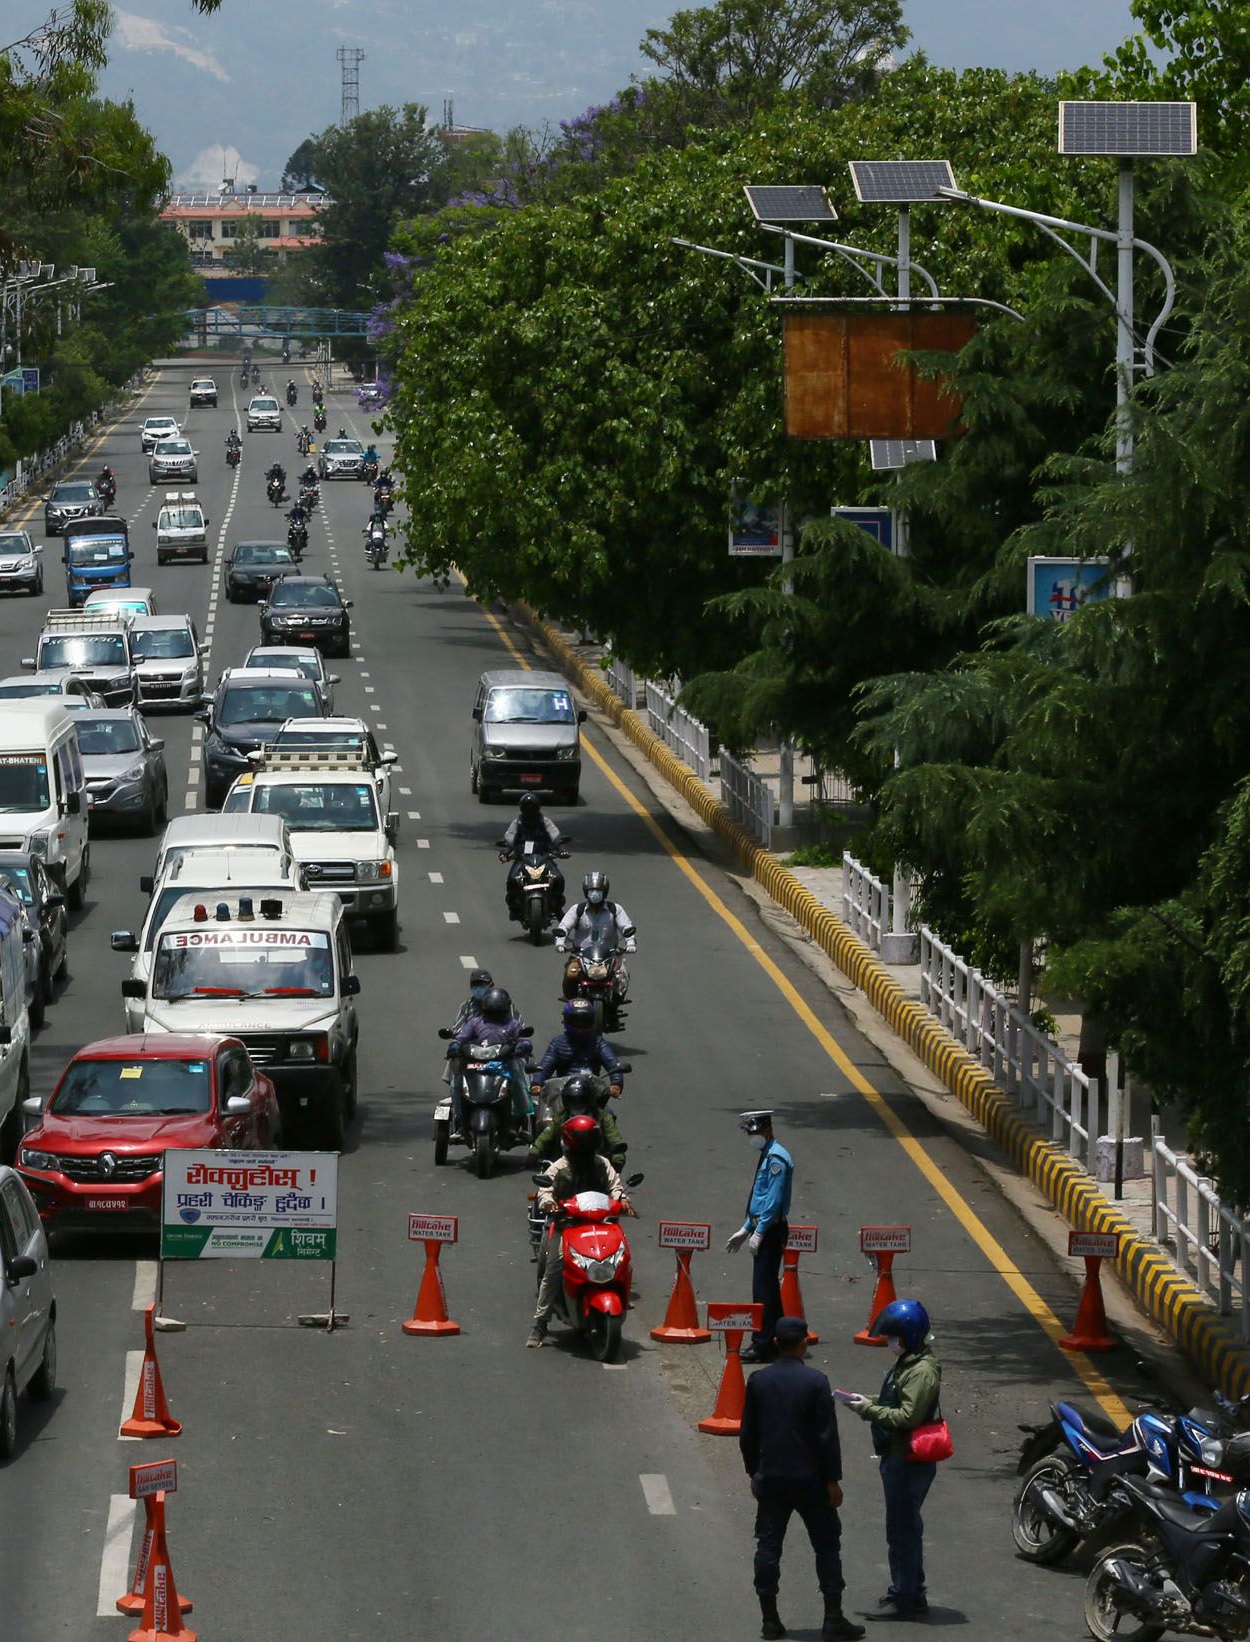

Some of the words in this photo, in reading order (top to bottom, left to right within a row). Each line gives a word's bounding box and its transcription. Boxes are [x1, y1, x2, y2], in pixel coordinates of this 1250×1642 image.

[553, 697, 568, 710] H
[186, 1164, 303, 1191] रोक्नुहोस्
[309, 1168, 317, 1186] !
[177, 1192, 213, 1208] प्रहरी
[222, 1240, 264, 1248] COMPROMISE
